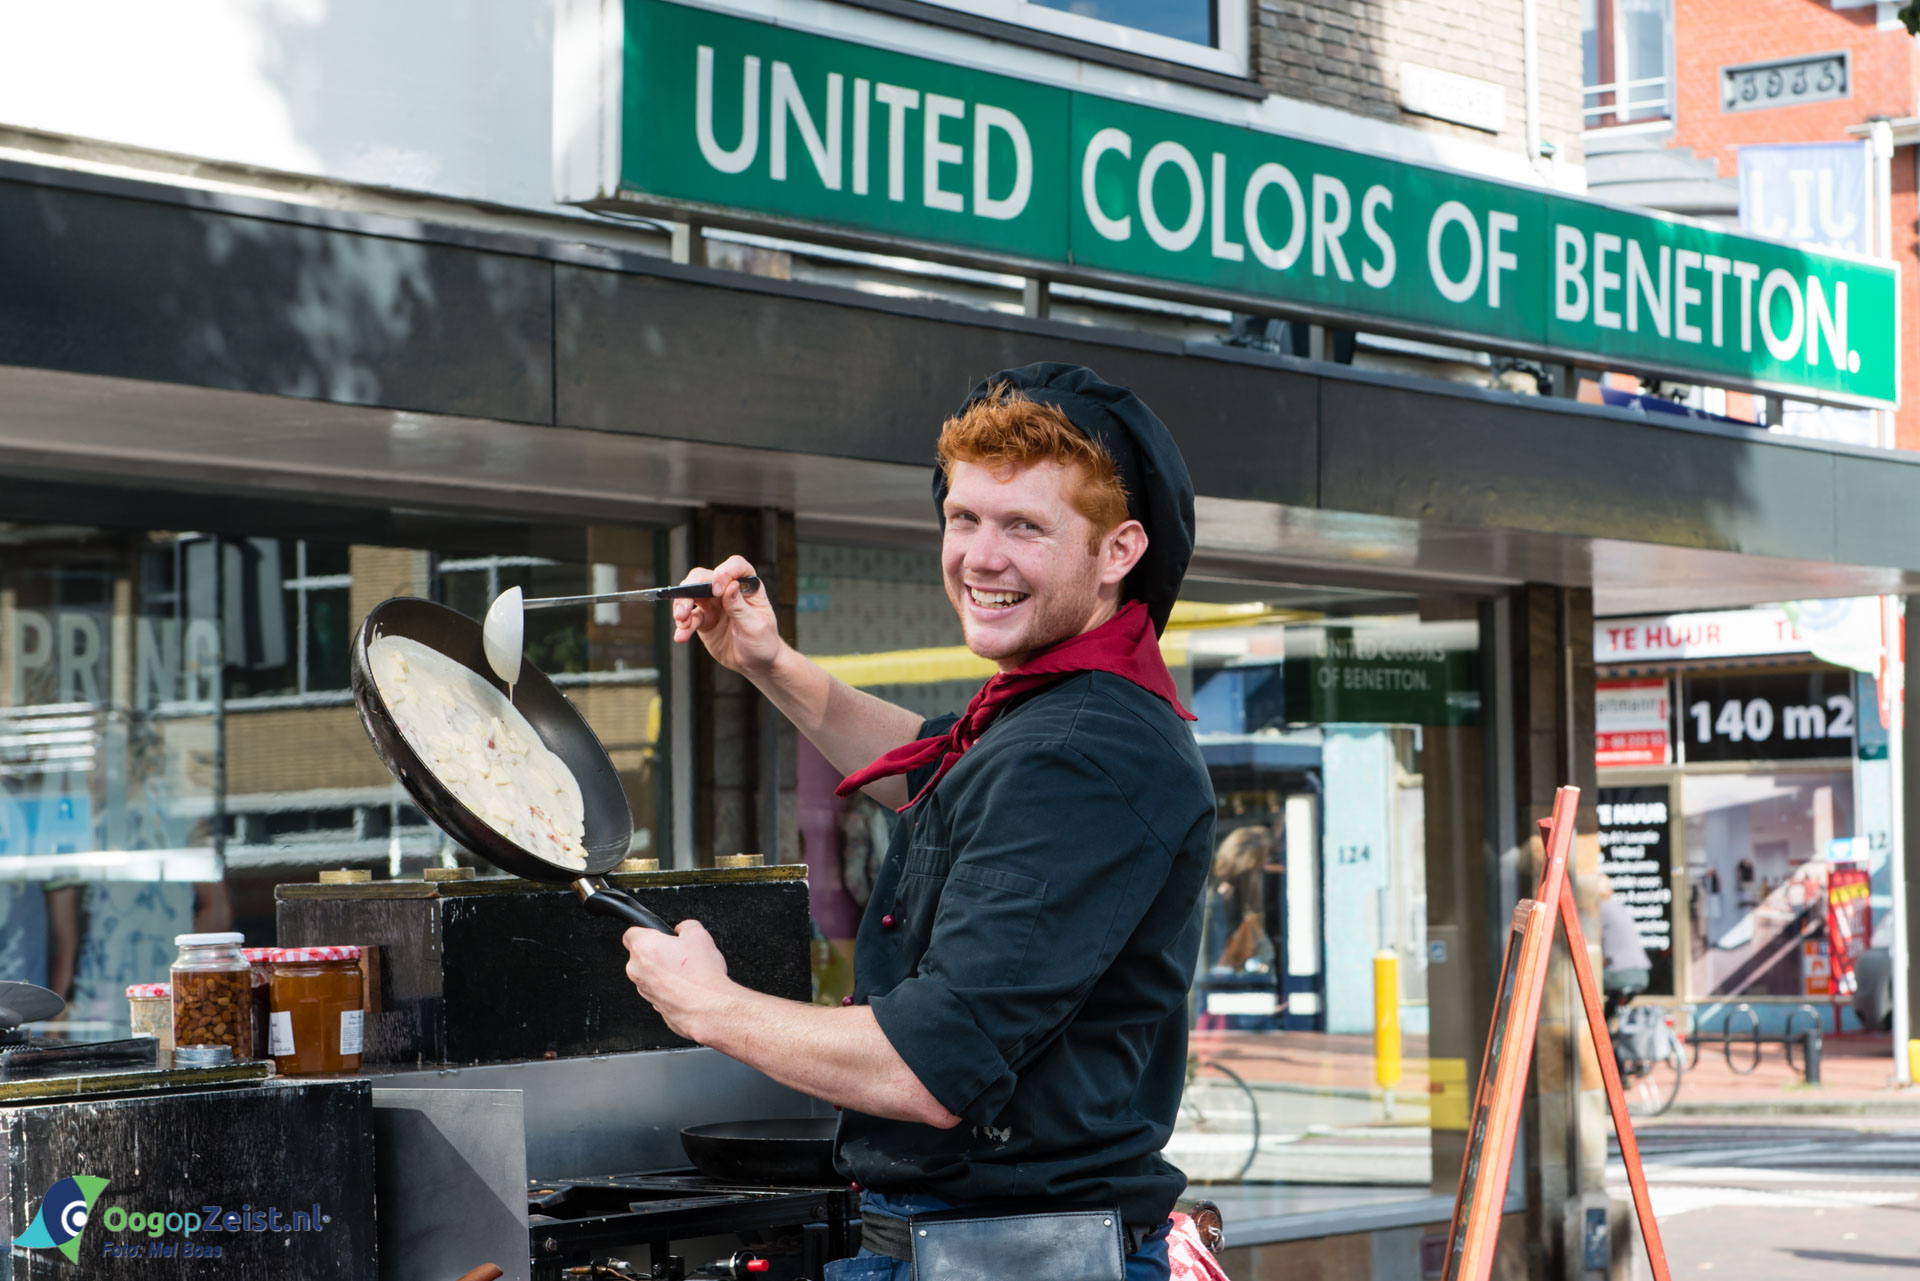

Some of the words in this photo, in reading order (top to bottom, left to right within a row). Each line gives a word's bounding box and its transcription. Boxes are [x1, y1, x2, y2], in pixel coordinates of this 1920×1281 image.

[697, 45, 1033, 221] UNITED
[1081, 128, 1397, 289] COLORS
[1427, 200, 1518, 309] OF
[1555, 224, 1861, 374] BENETTON.
[1607, 627, 1637, 651] TE
[1645, 624, 1721, 649] HUUR
[1317, 666, 1340, 689] OF
[1690, 697, 1774, 743] 140
[1783, 694, 1855, 740] m2
[1338, 846, 1371, 864] 124
